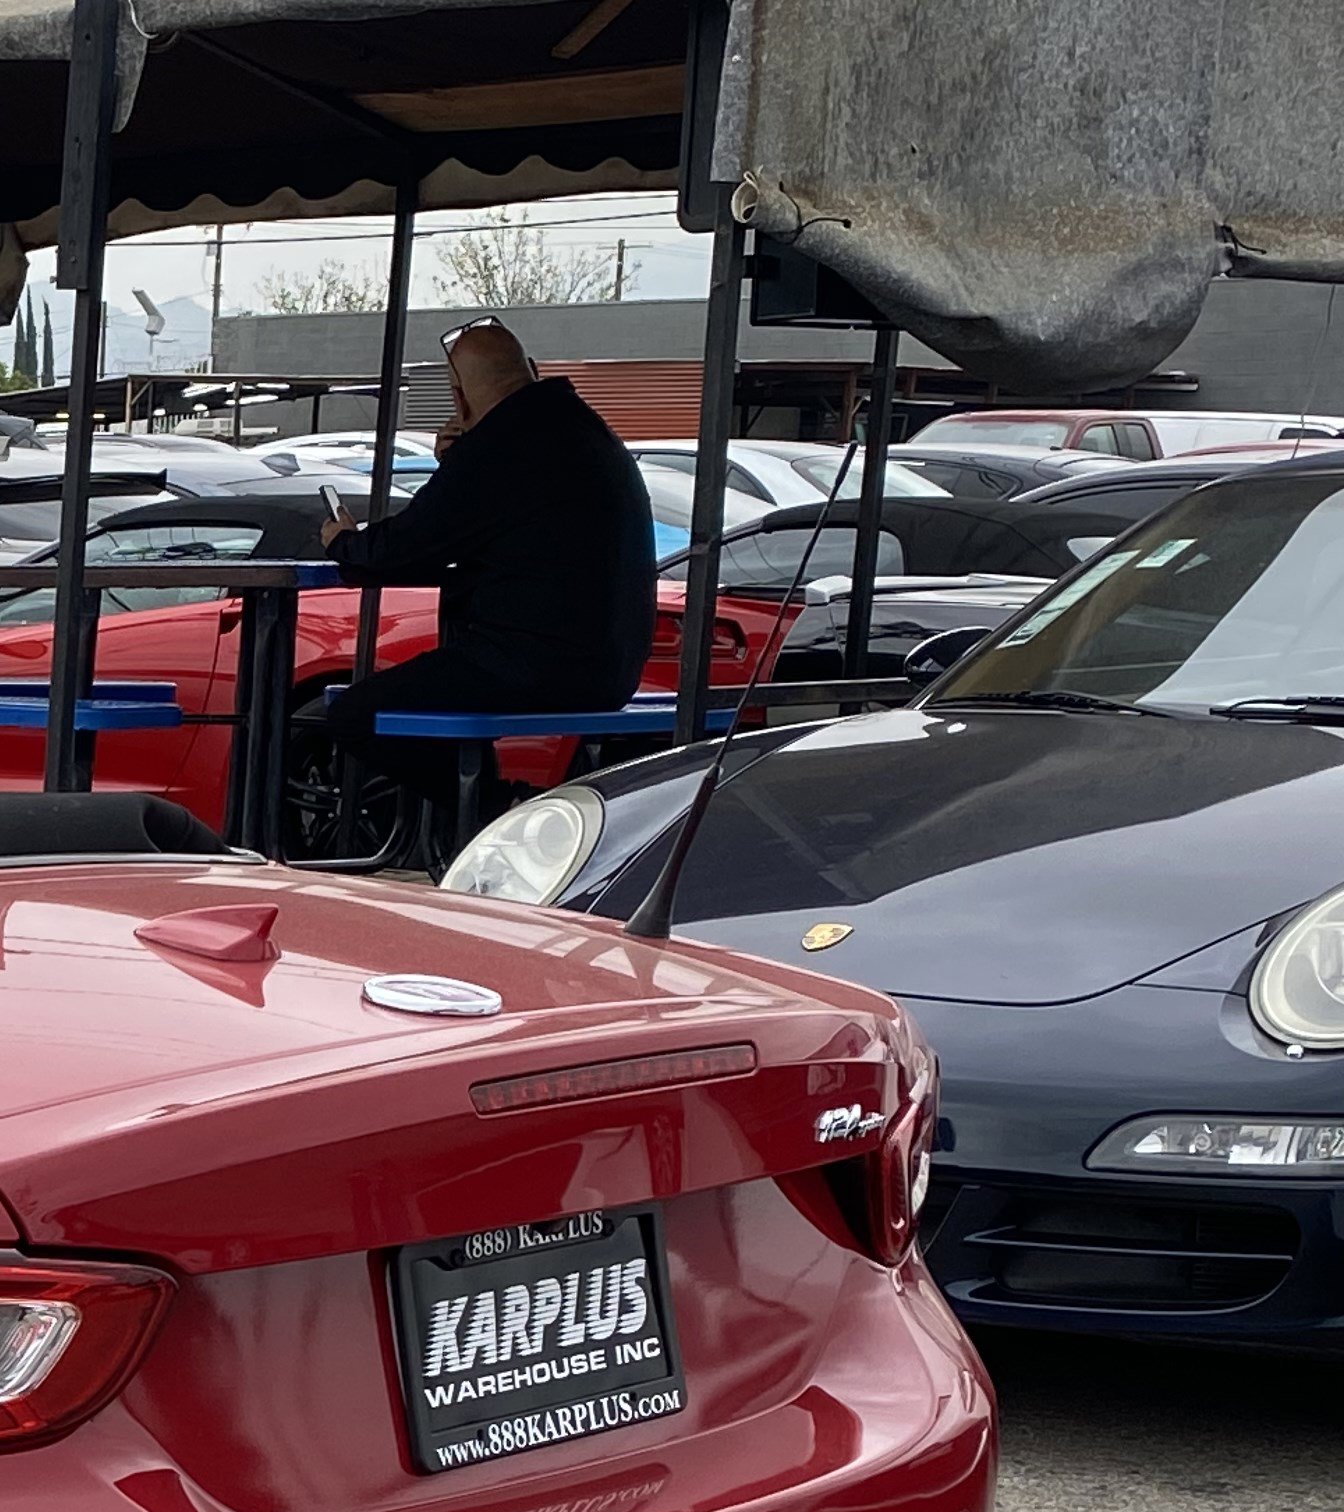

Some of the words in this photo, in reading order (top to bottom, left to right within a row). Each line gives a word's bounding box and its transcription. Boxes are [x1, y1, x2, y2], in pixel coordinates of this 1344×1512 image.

[465, 1228, 512, 1260] (888)
[422, 1258, 646, 1377] KARPLUS
[424, 1350, 607, 1408] WAREHOUSE
[616, 1337, 661, 1366] INC
